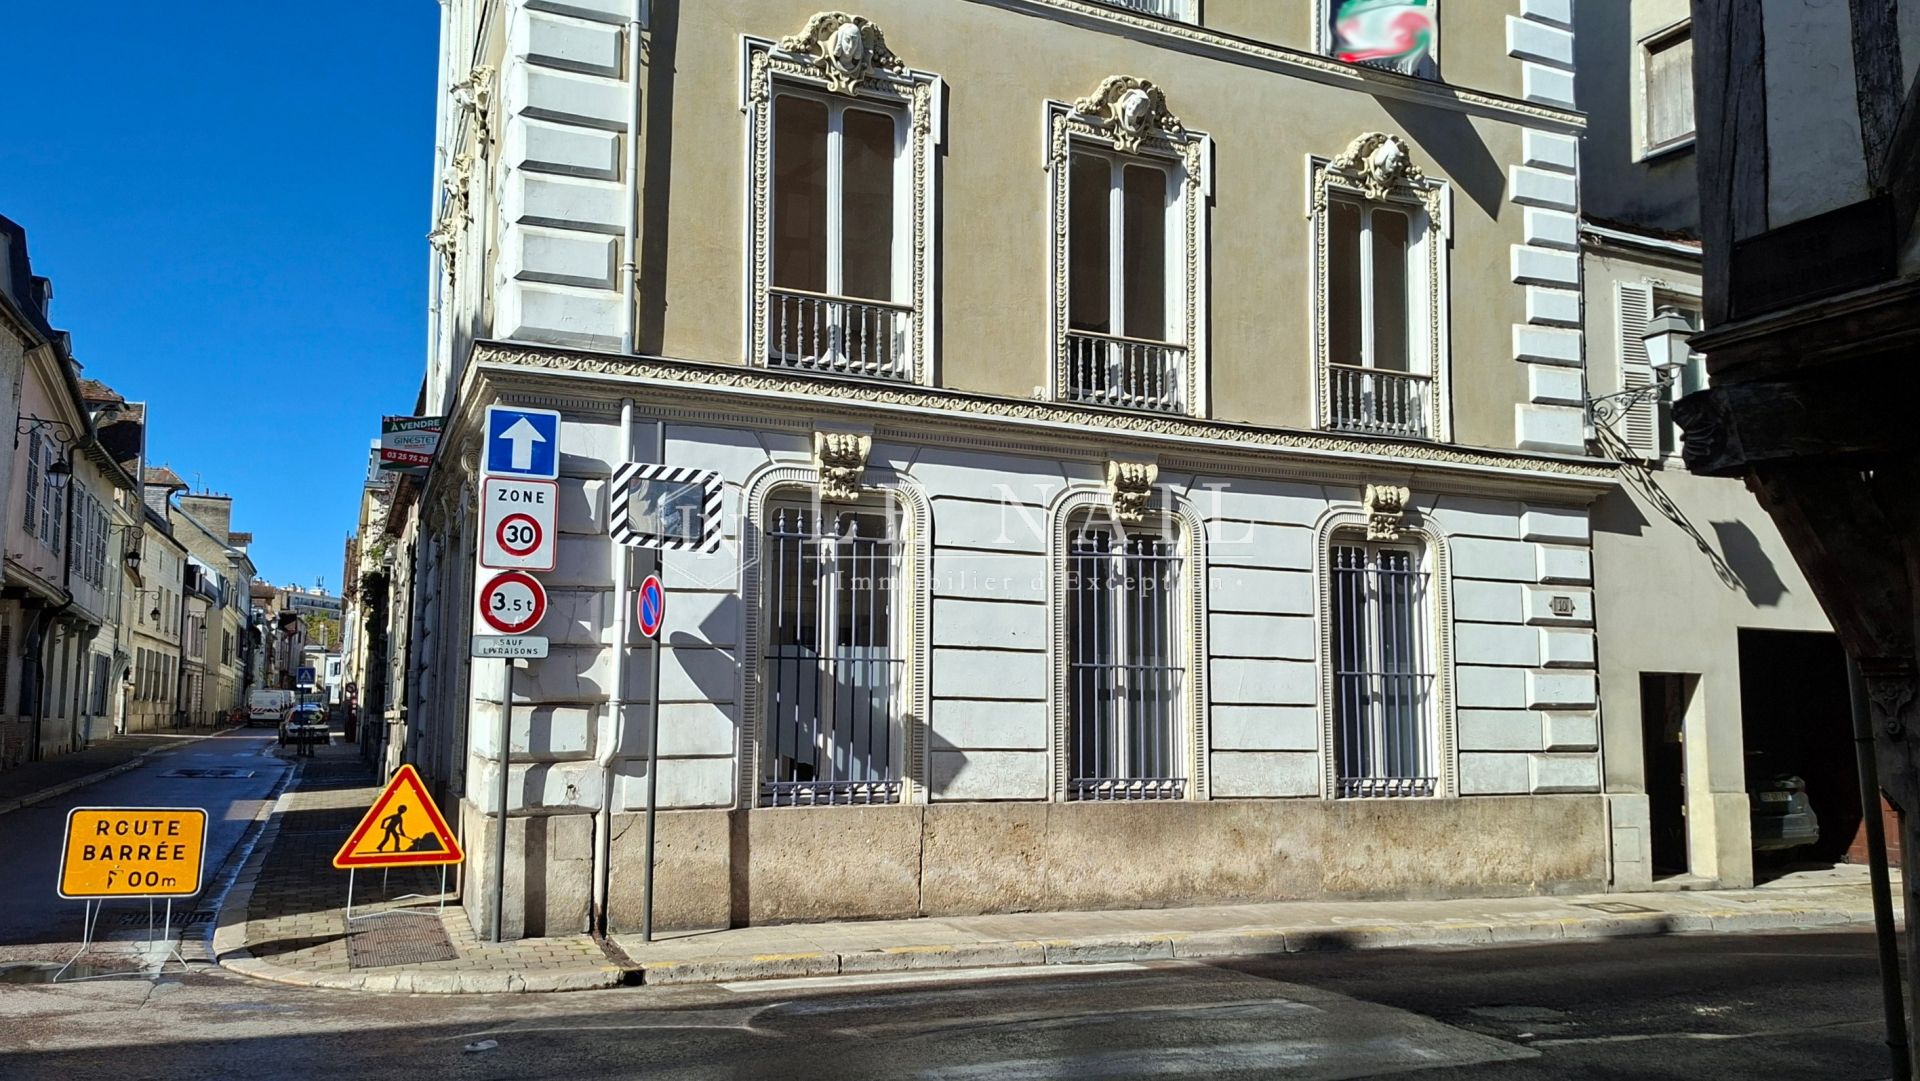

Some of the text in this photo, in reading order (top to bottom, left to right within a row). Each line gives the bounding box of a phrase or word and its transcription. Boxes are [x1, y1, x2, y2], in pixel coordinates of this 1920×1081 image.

[400, 419, 440, 430] VENDRE
[394, 435, 435, 444] GINESTET
[387, 451, 397, 459] 03
[397, 452, 407, 460] 25
[408, 454, 418, 462] 75
[498, 488, 545, 503] ZONE
[505, 525, 534, 544] 30
[483, 647, 538, 655] LIVRAISONS
[96, 820, 180, 836] ROUTE
[82, 841, 186, 860] BARRÉE
